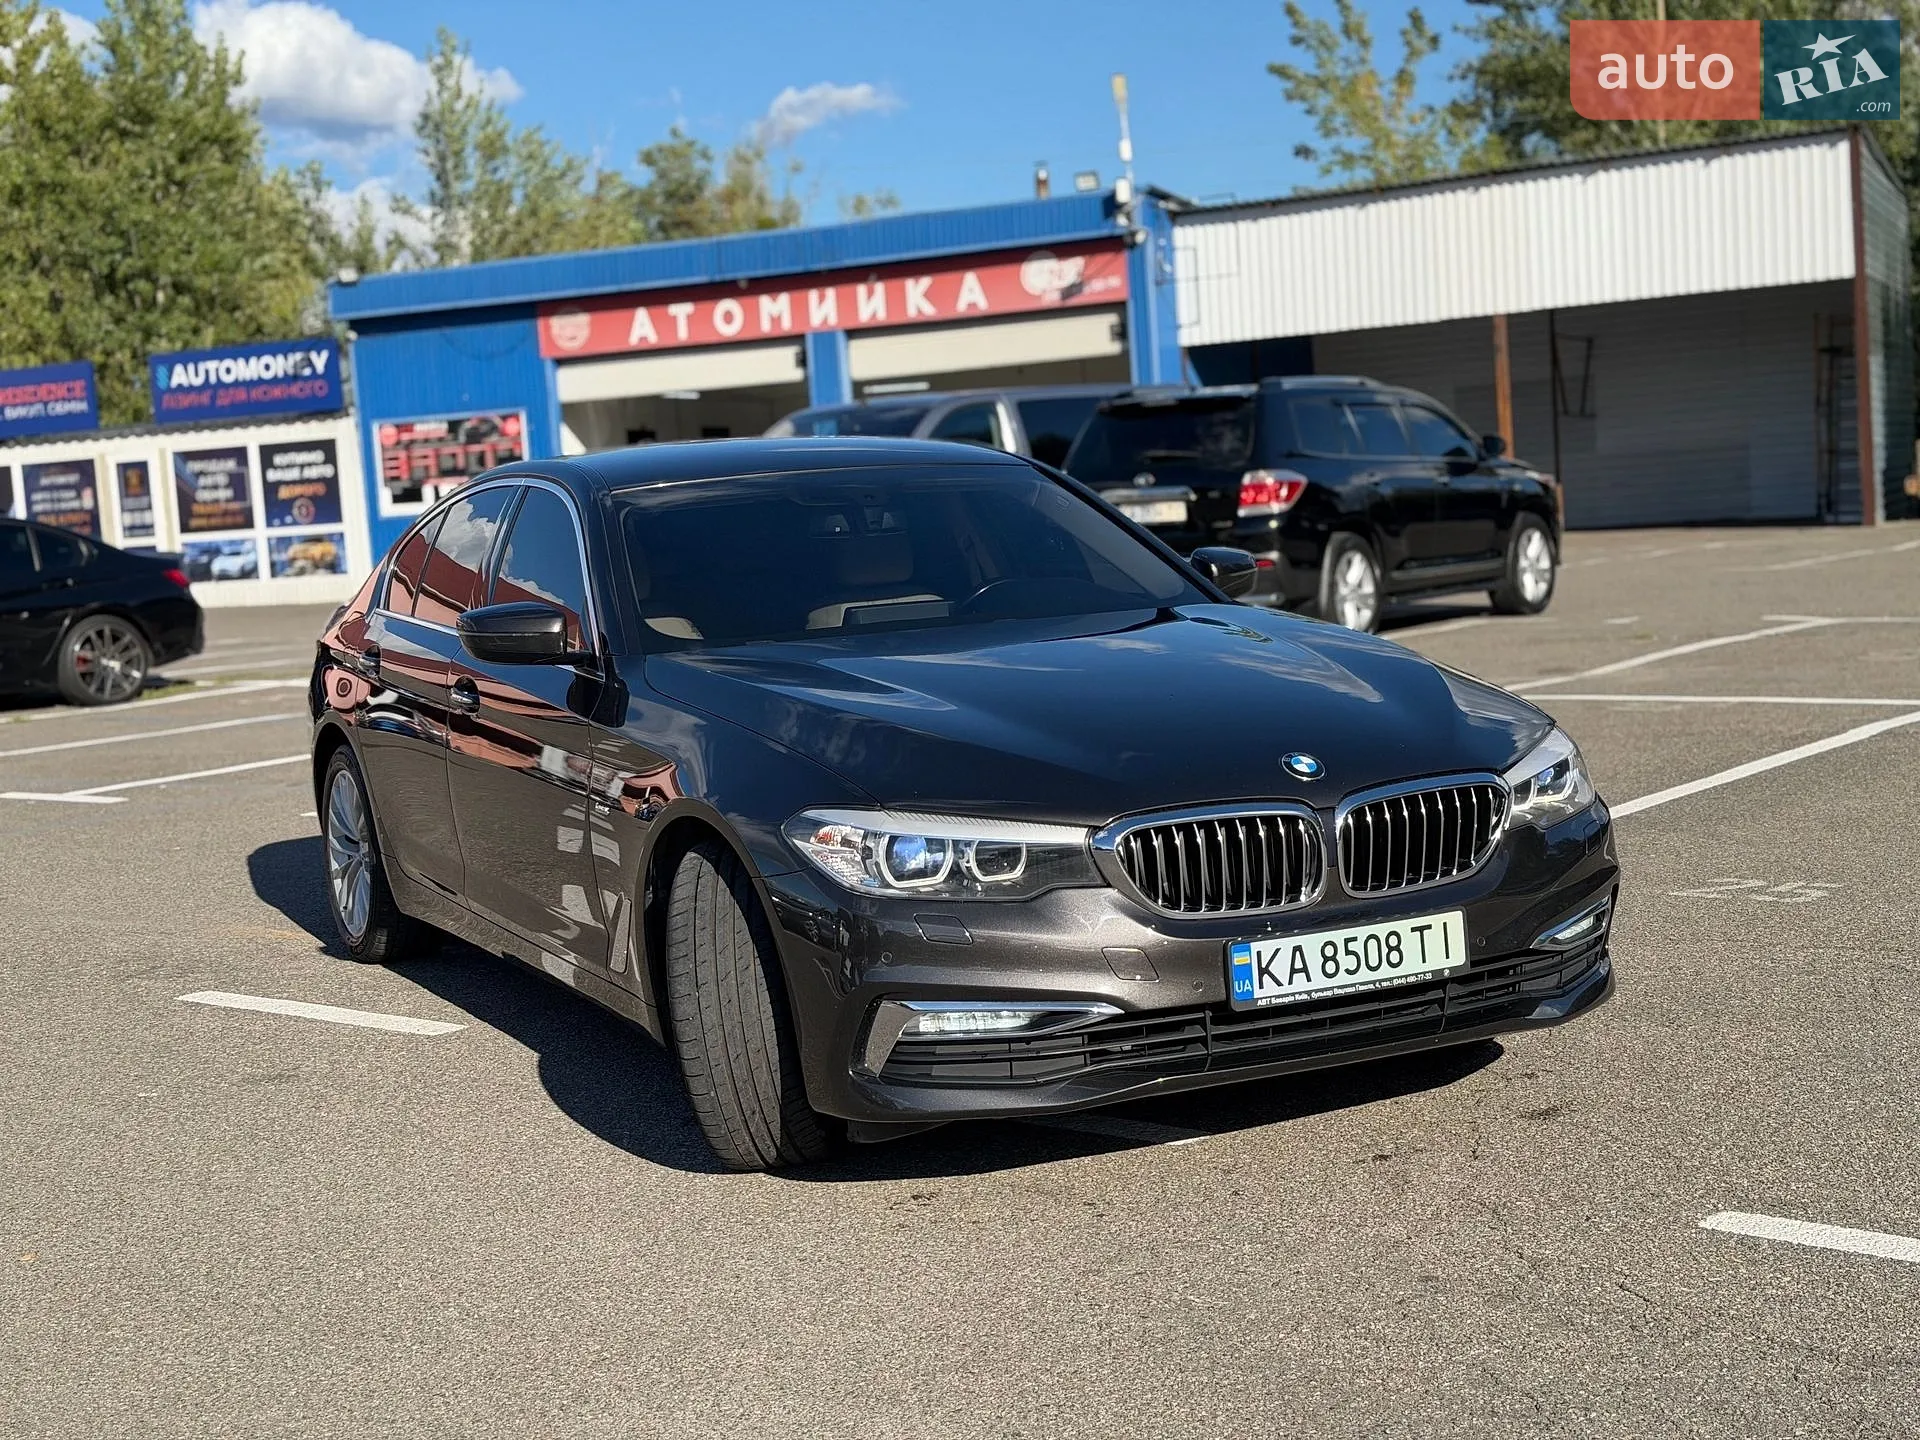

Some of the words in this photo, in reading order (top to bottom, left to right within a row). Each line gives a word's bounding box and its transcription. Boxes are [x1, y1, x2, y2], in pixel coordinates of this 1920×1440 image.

[627, 271, 989, 347] АТОМИЙКА
[169, 348, 330, 389] AUTOMONEY
[1256, 944, 1313, 990] KA
[1320, 930, 1404, 979] 8508
[1410, 921, 1451, 964] TI
[1235, 979, 1253, 993] UA
